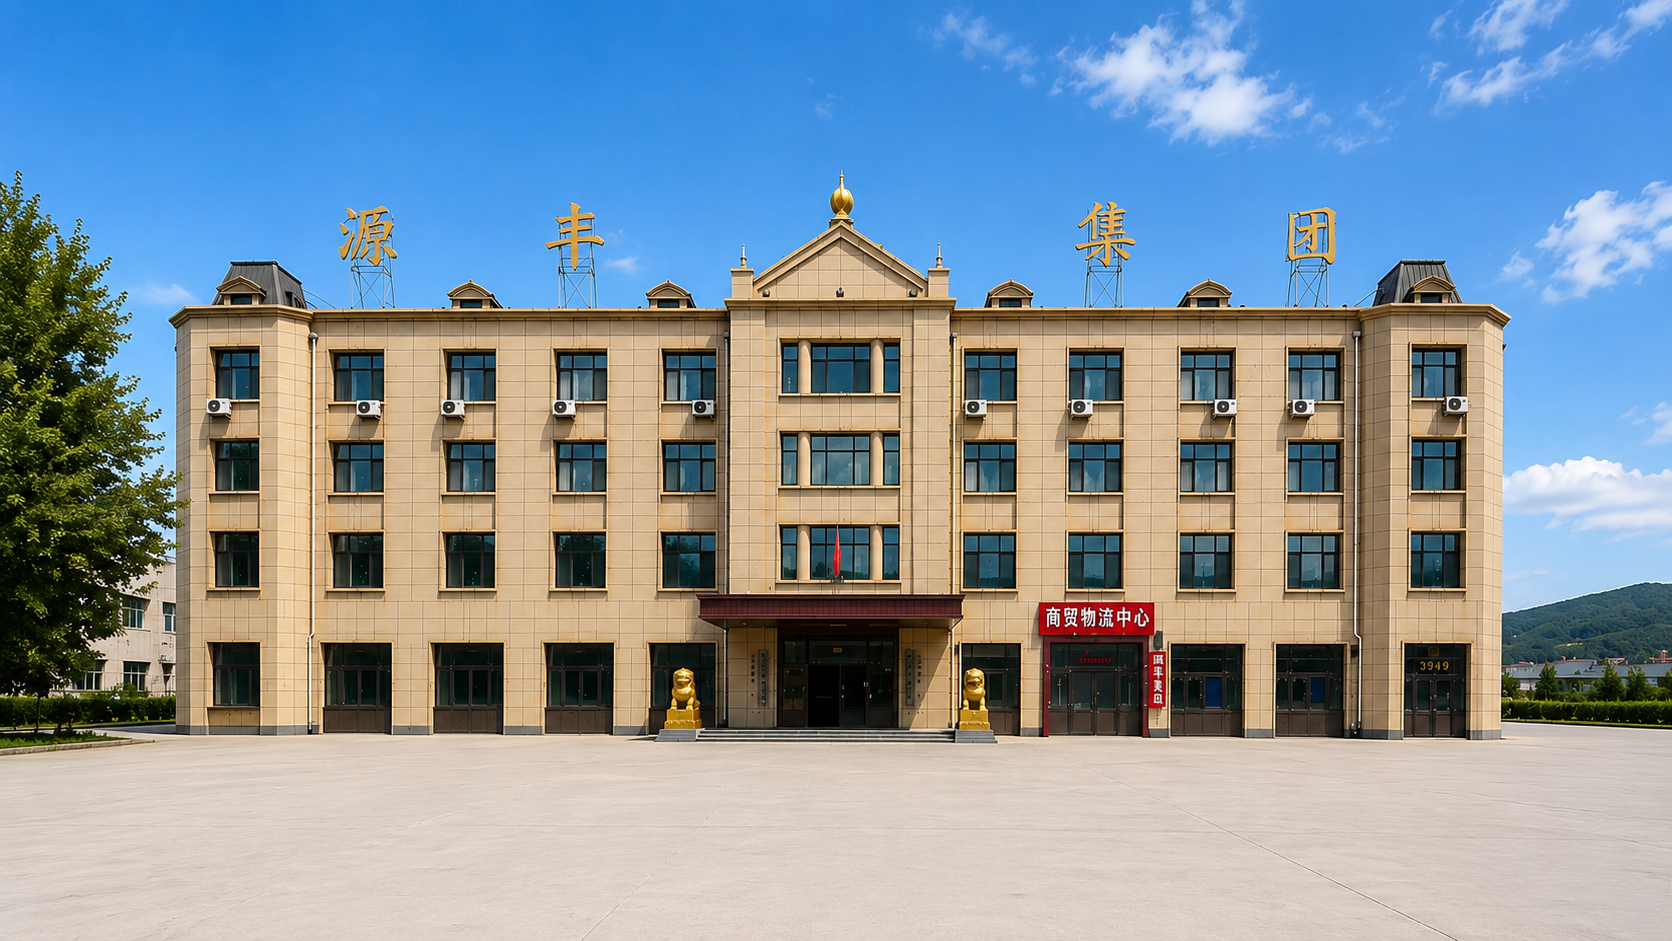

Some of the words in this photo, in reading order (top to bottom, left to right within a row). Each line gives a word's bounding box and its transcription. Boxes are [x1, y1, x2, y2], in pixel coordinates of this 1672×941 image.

[1046, 606, 1149, 628] 商贸物流中心
[1420, 661, 1449, 671] 3949
